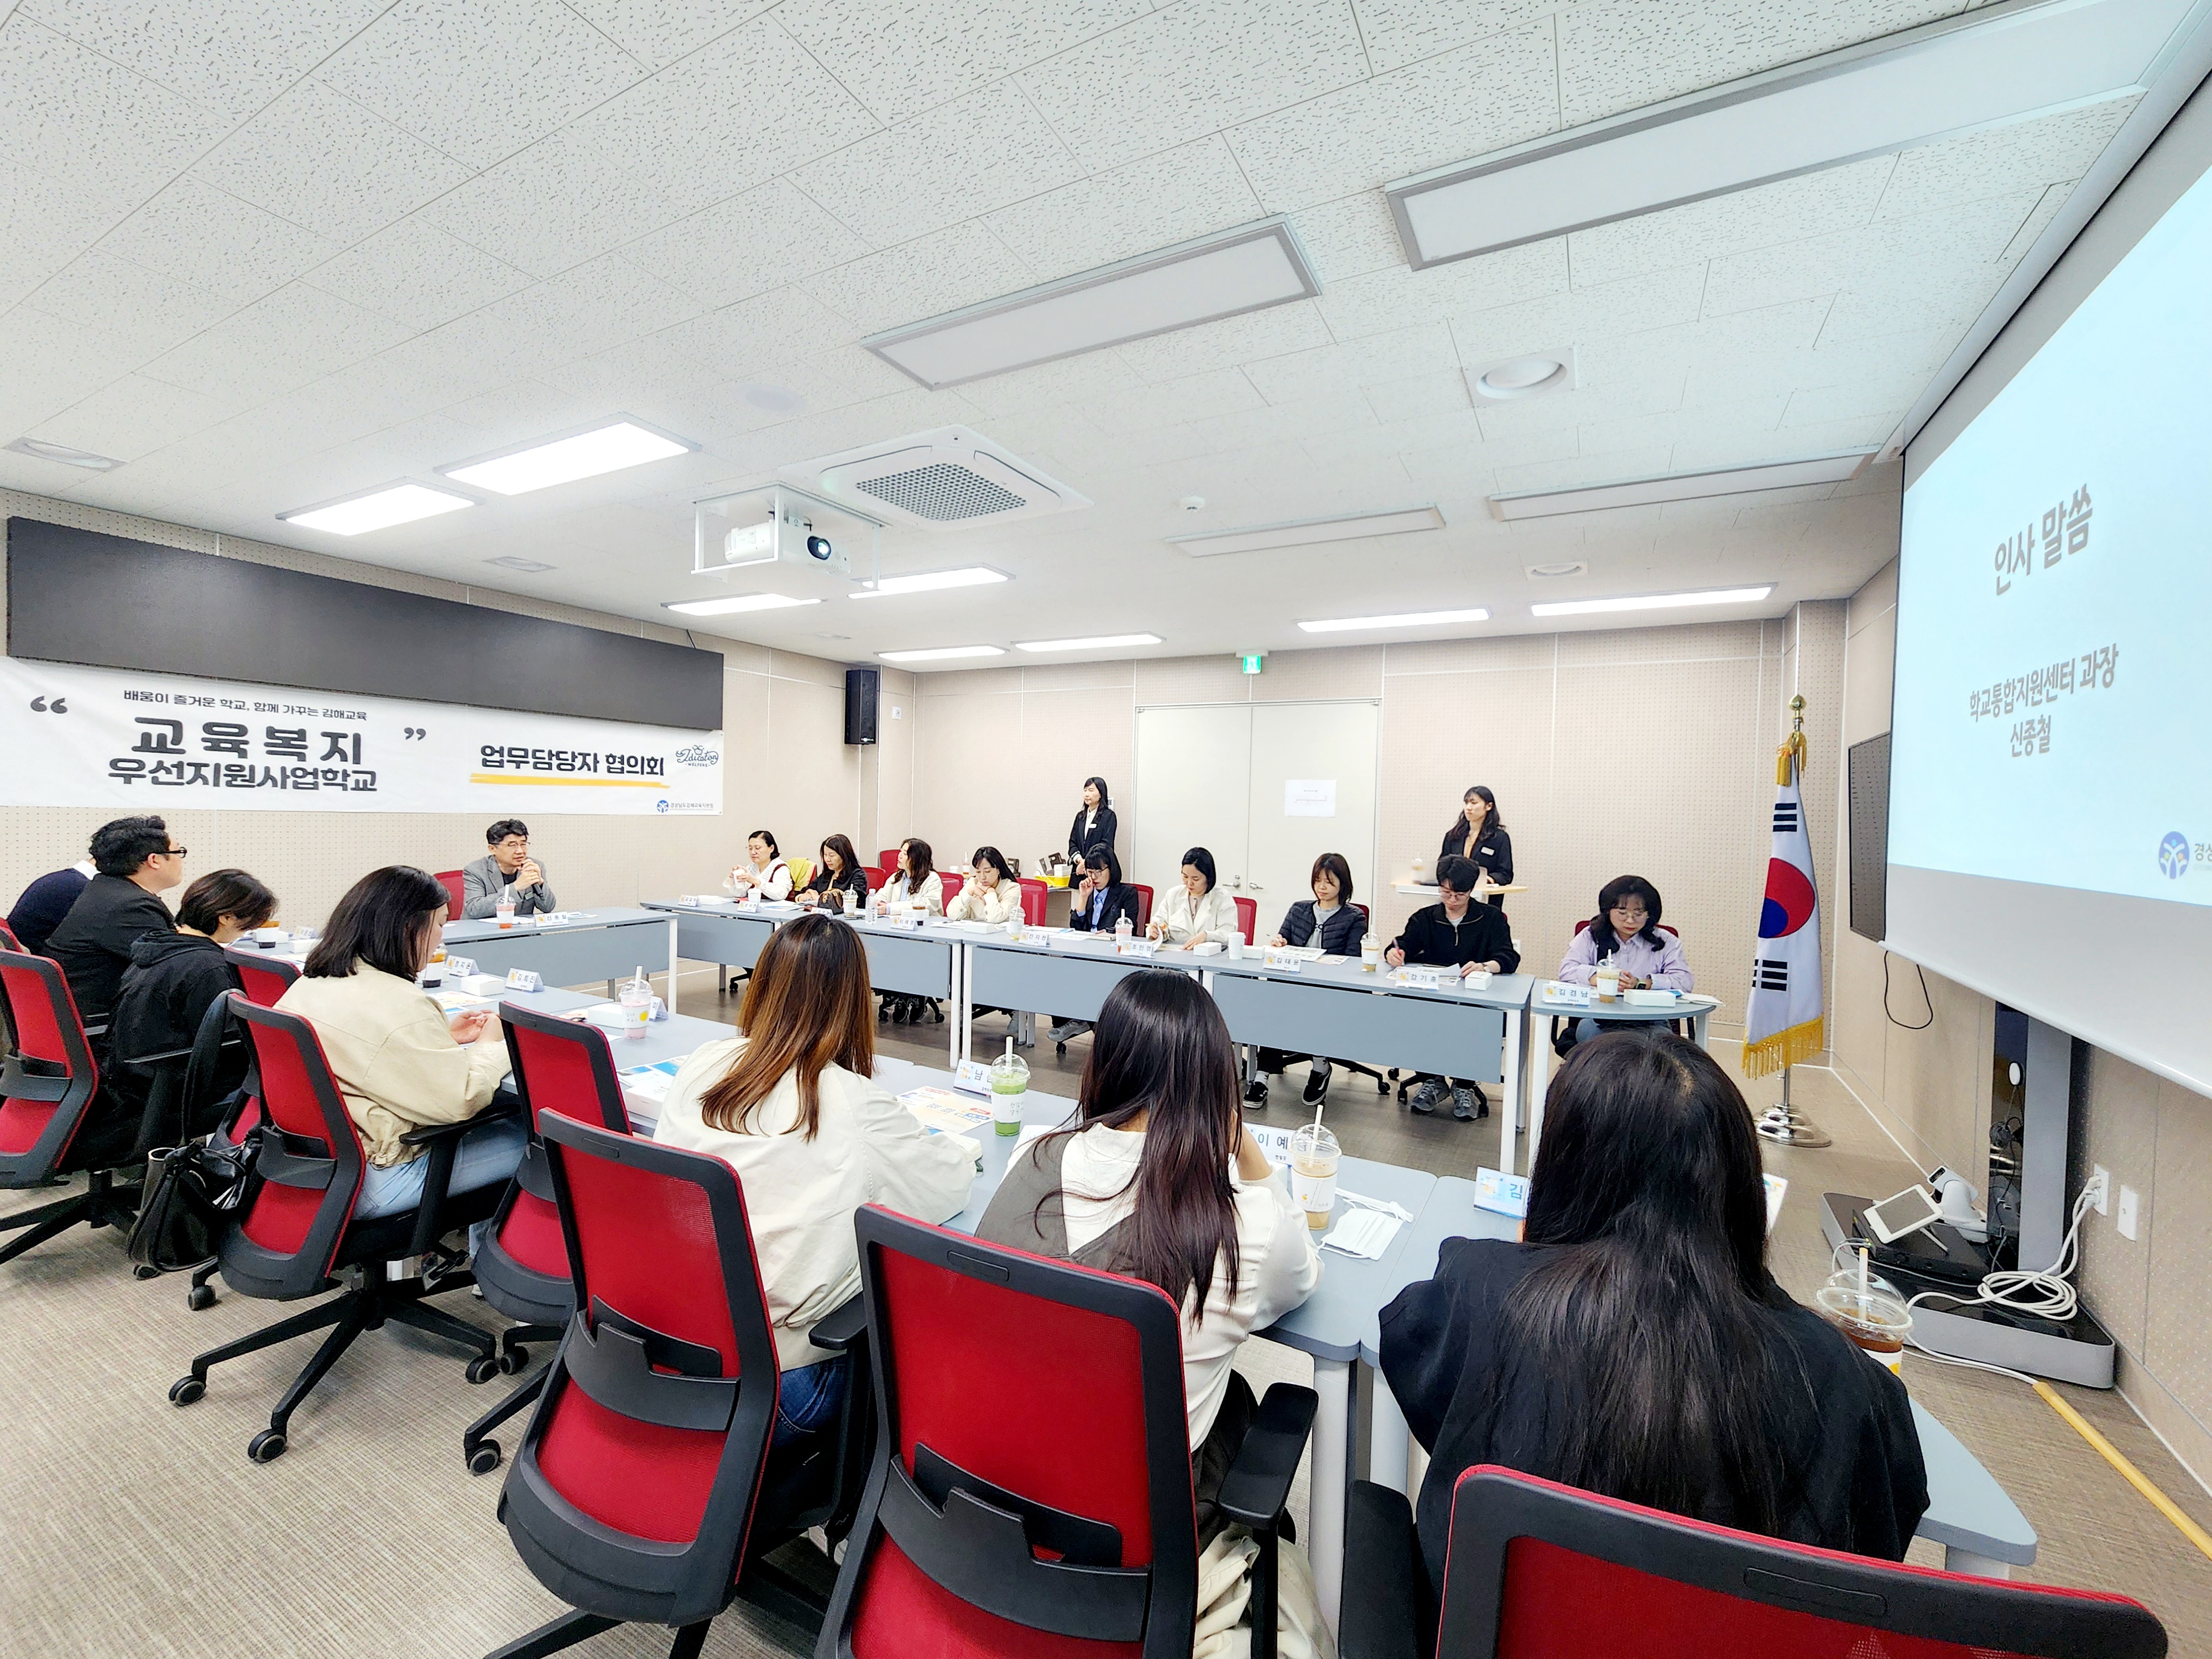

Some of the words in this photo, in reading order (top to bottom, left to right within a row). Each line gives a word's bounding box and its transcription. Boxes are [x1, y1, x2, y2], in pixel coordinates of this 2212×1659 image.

[1994, 523, 2036, 596] 인사
[2042, 483, 2093, 569] 말씀
[1970, 657, 2076, 723] 학교통합지원센터
[2079, 642, 2120, 689] 과장
[124, 690, 169, 704] 배움이
[174, 693, 216, 708] 즐거운
[220, 698, 250, 712] 학교,
[254, 701, 279, 714] 함께
[283, 704, 319, 717] 가꾸는
[322, 708, 367, 721] 김해교육
[2010, 713, 2052, 758] 신종철
[108, 757, 378, 792] 우선지원사업학교
[480, 744, 599, 773] 업무담당자
[604, 753, 665, 776] 협의회
